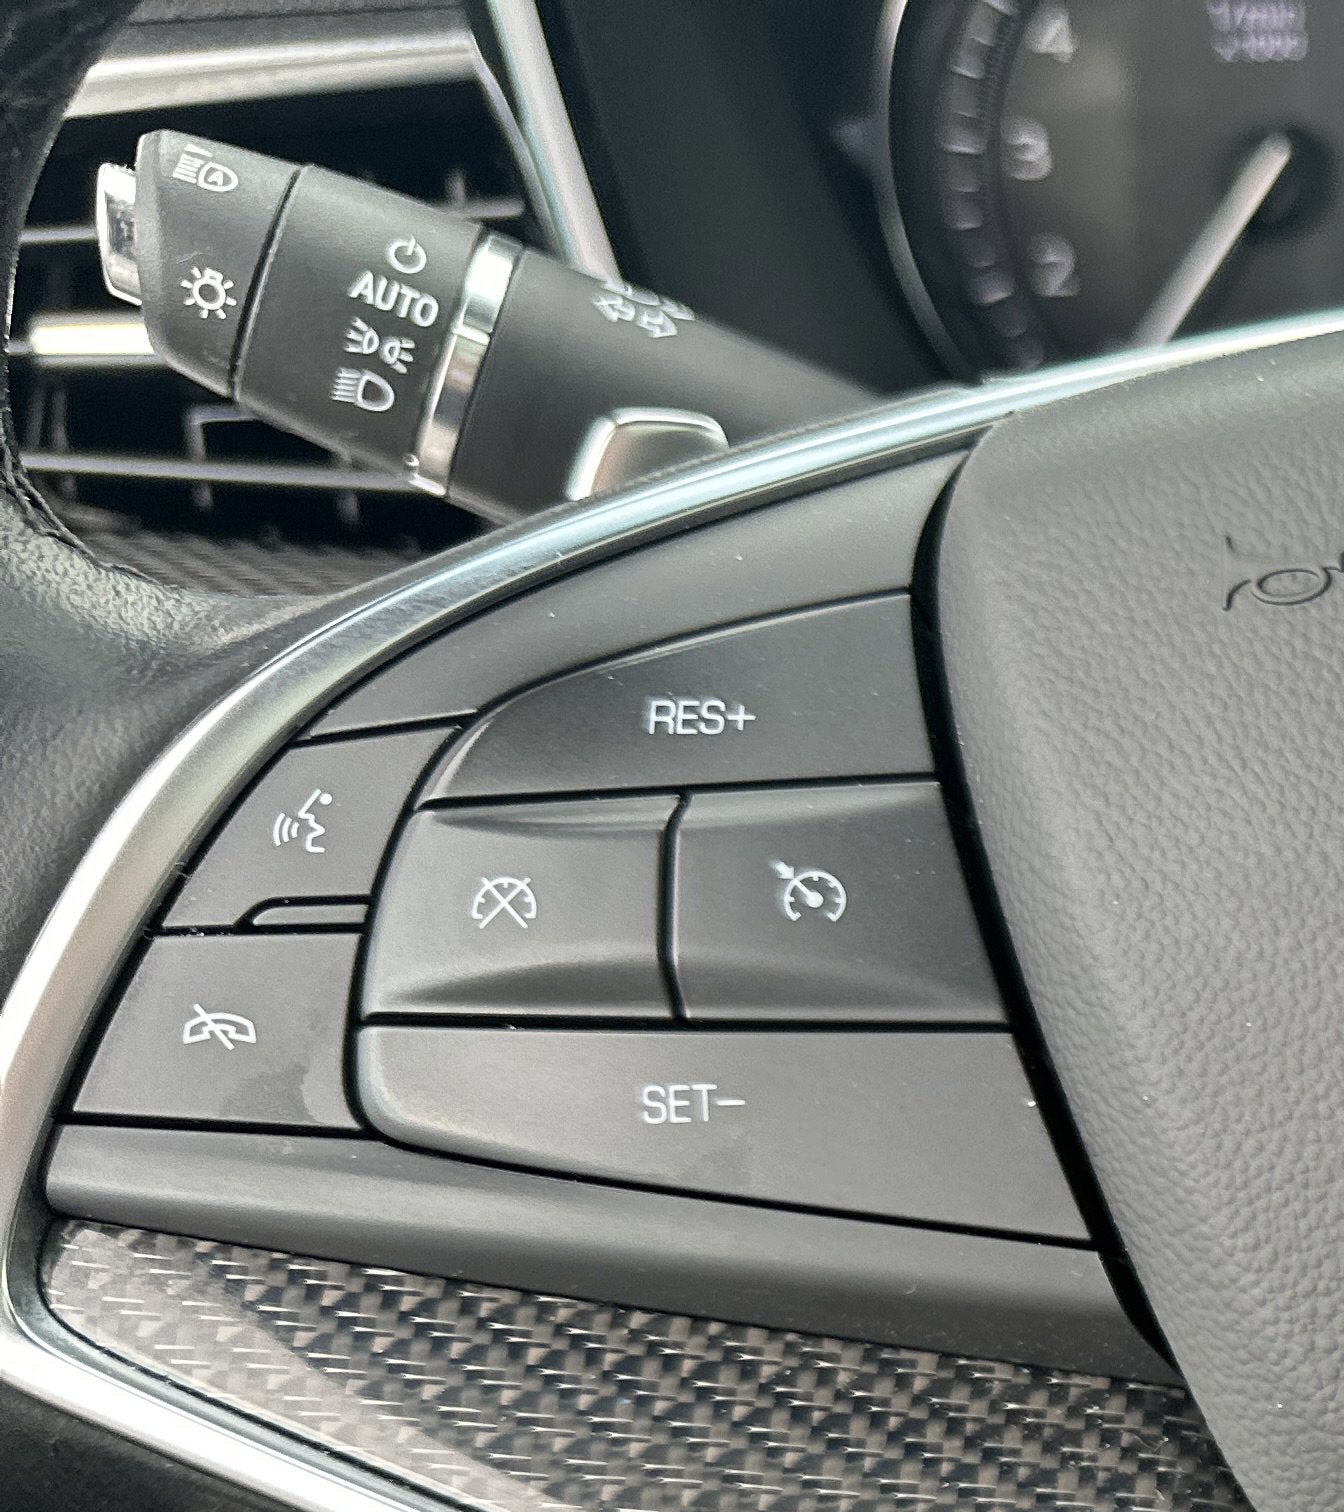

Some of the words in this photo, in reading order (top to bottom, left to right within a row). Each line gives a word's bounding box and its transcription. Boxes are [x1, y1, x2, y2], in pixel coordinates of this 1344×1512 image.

[346, 268, 440, 328] AUTO
[647, 698, 757, 736] RES+
[642, 1083, 747, 1125] SET-
